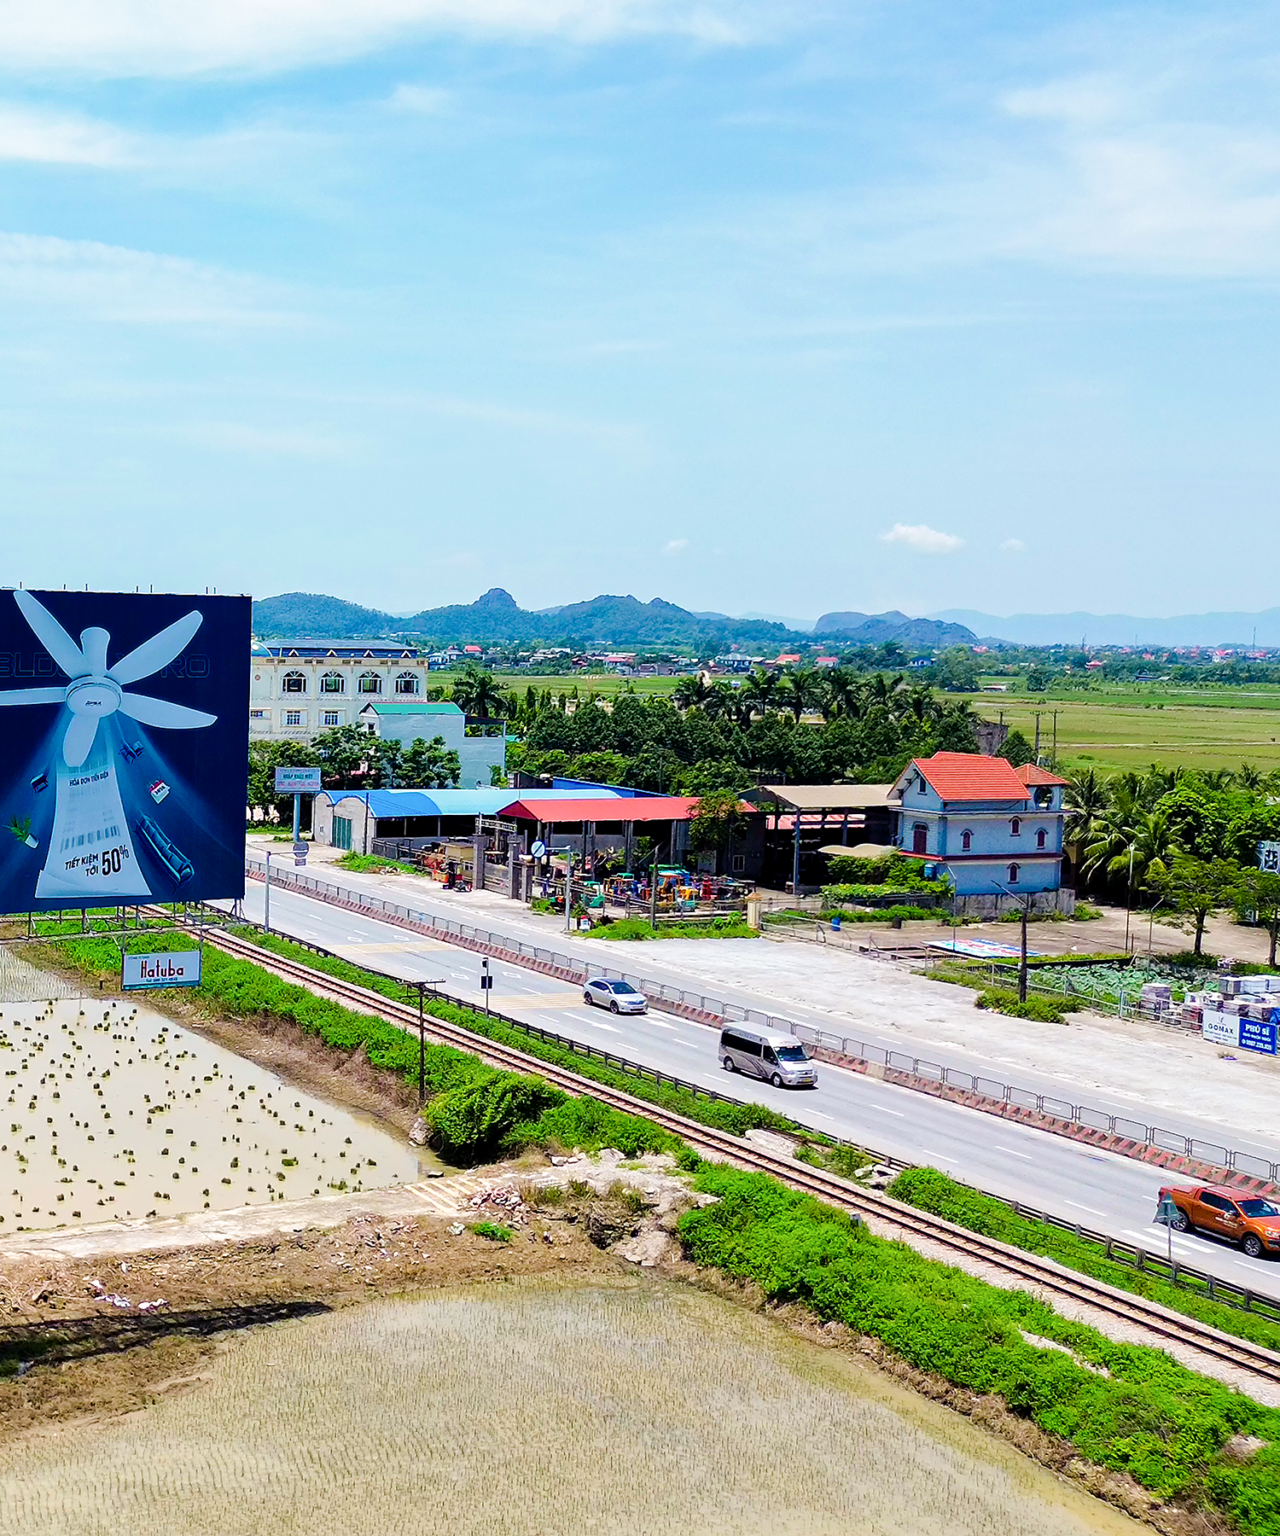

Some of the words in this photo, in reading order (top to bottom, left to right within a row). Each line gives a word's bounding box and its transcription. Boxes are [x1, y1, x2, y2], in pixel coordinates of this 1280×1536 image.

[64, 857, 81, 871] TIẾT
[81, 853, 99, 864] KIỆM
[85, 864, 99, 877] TỚI
[102, 844, 130, 876] 50%
[141, 959, 184, 978] Hatuba
[1208, 1023, 1234, 1034] GOMAX
